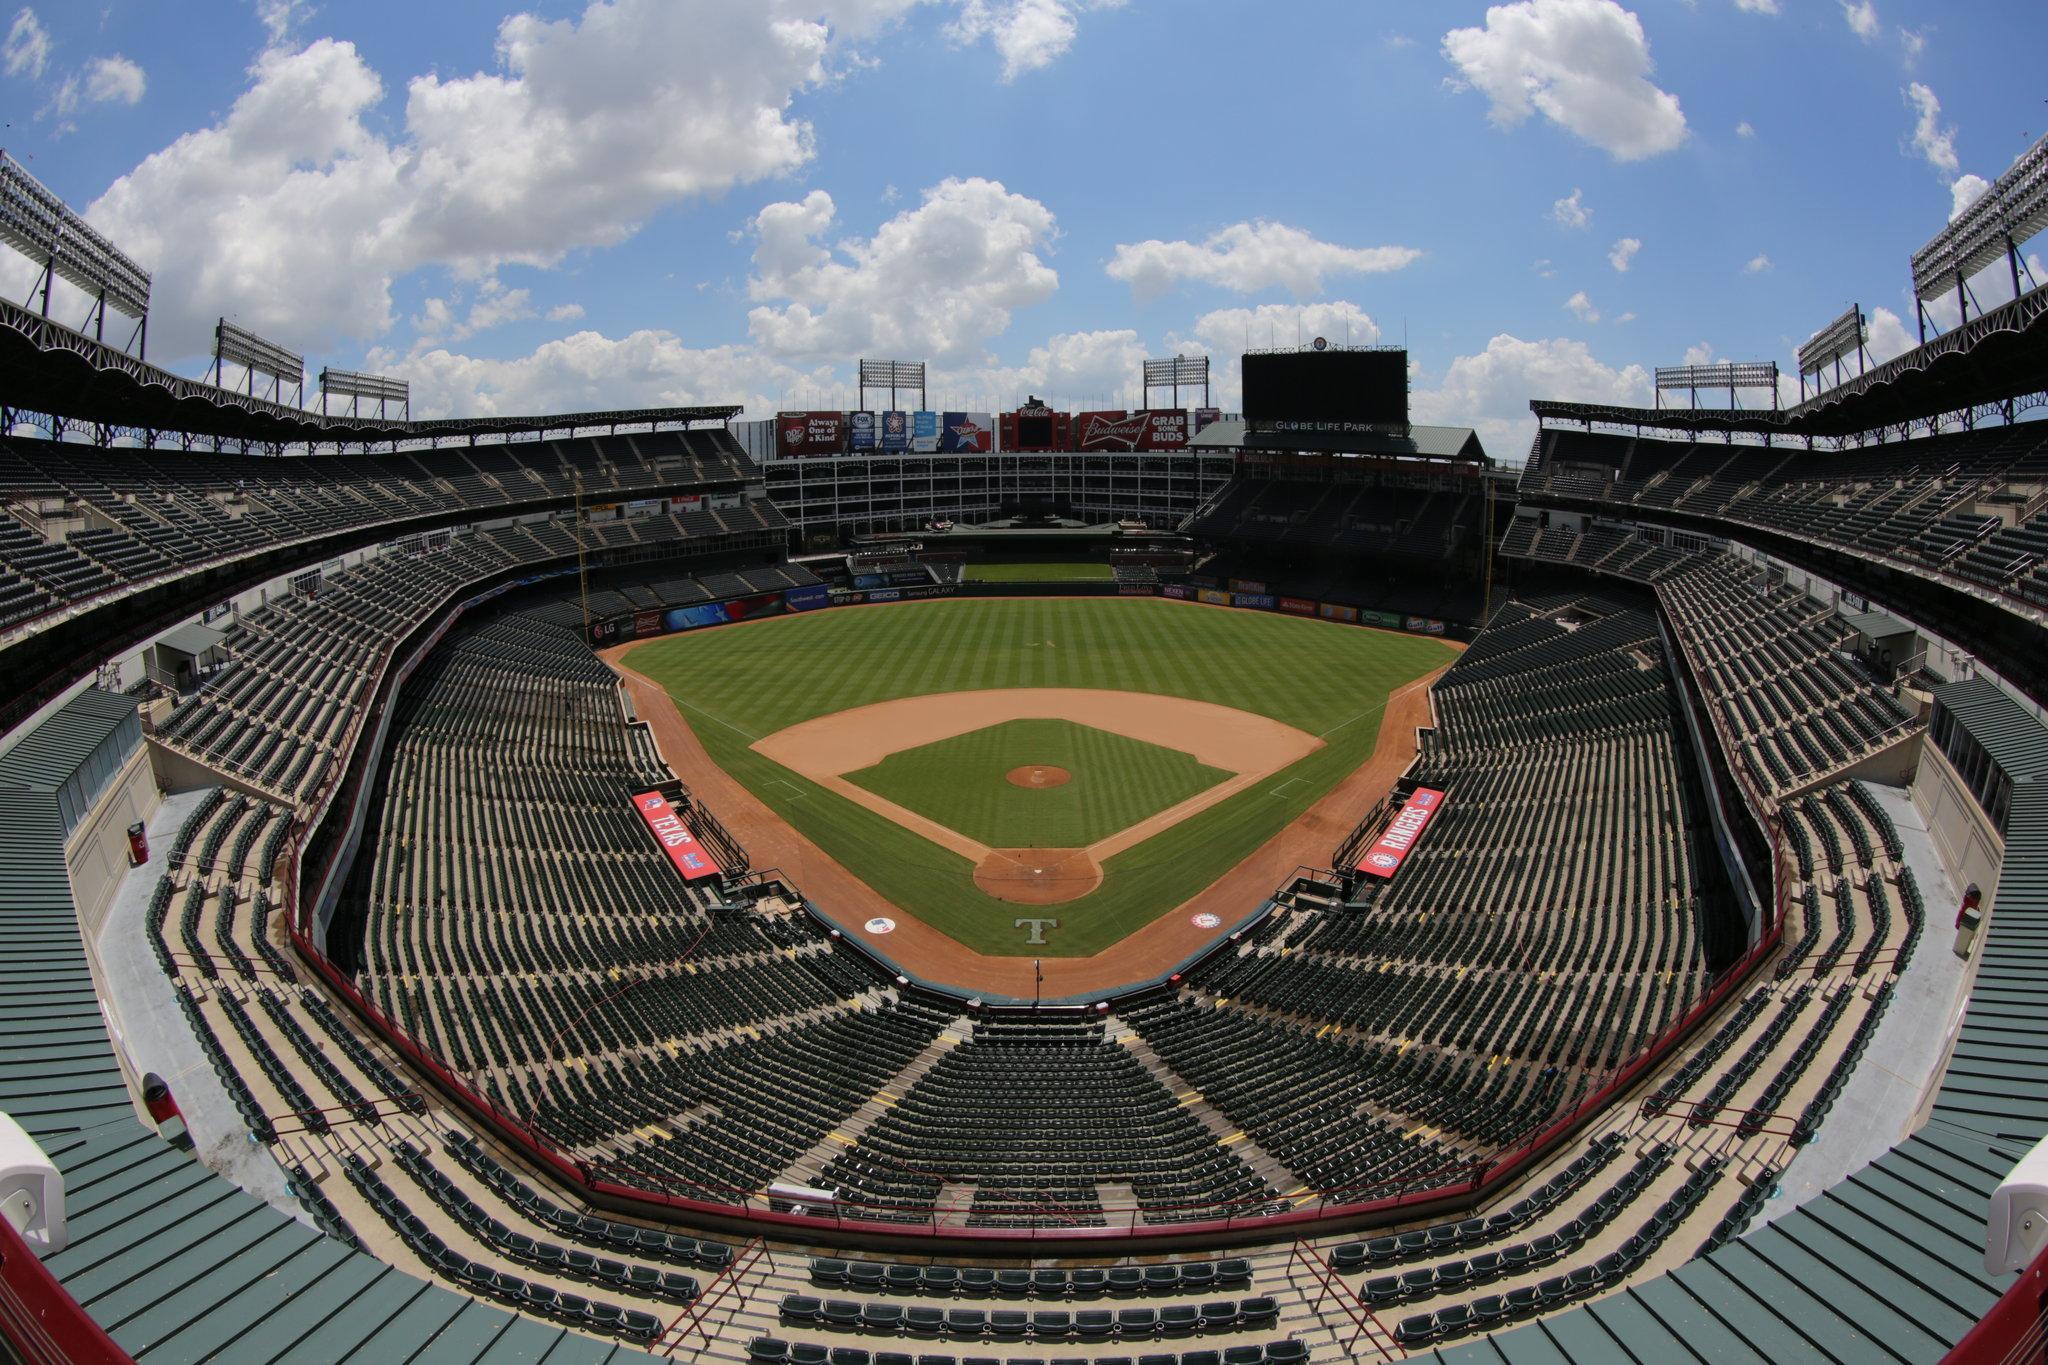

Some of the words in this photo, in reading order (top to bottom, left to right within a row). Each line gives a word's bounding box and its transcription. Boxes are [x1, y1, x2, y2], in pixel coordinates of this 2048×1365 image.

[808, 418, 839, 428] Always
[1152, 416, 1184, 426] GRAB
[1275, 420, 1314, 431] GLOBE
[1316, 422, 1341, 432] LIFE
[1344, 422, 1374, 432] PARK
[1087, 422, 1146, 436] Budweiser
[814, 434, 836, 442] Kind
[1152, 432, 1184, 442] BUDS
[869, 591, 900, 600] GEICO
[928, 586, 955, 595] GALAXY
[604, 623, 615, 634] LG
[1407, 621, 1424, 629] Gulf
[1427, 624, 1444, 632] Gulf
[651, 814, 693, 847] TEXAS
[1380, 806, 1429, 850] RANGERS
[1014, 918, 1058, 944] T
